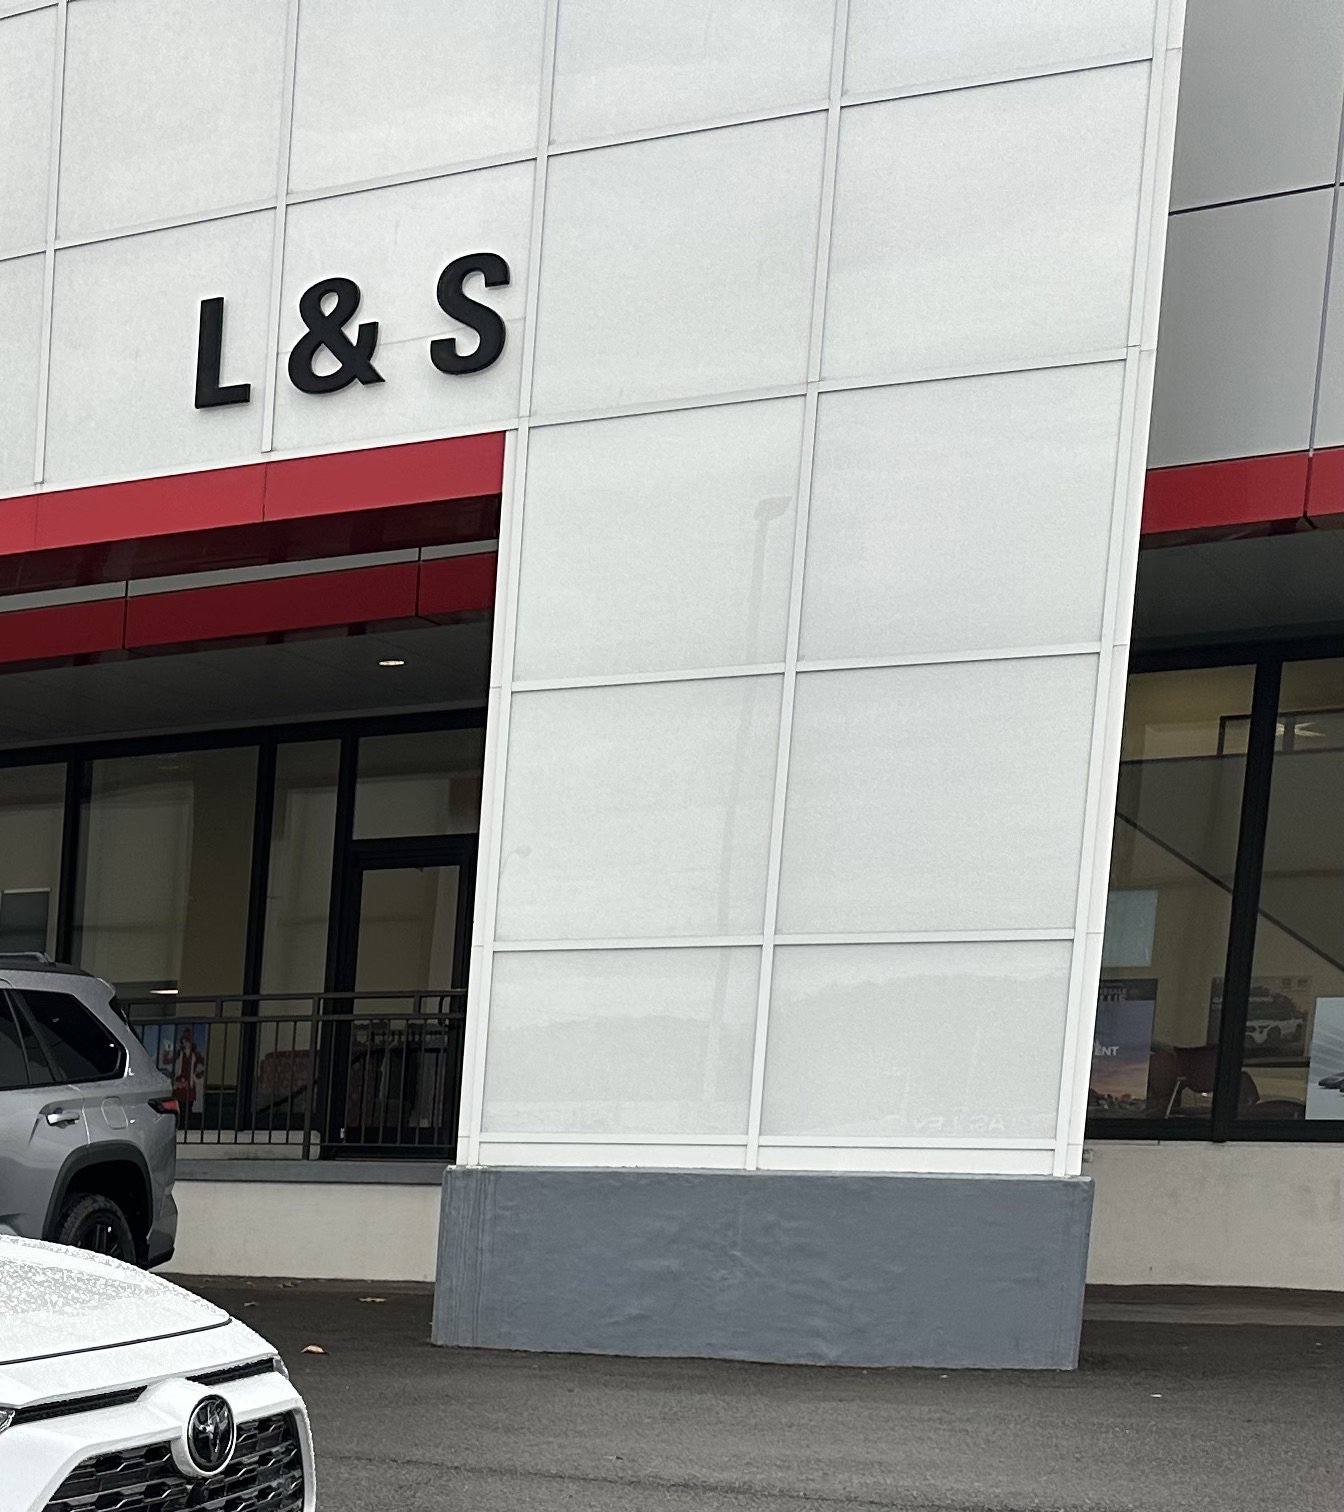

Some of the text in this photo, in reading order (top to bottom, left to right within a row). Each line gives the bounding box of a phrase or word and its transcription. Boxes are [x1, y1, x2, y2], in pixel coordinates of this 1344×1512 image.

[194, 252, 511, 409] L & S
